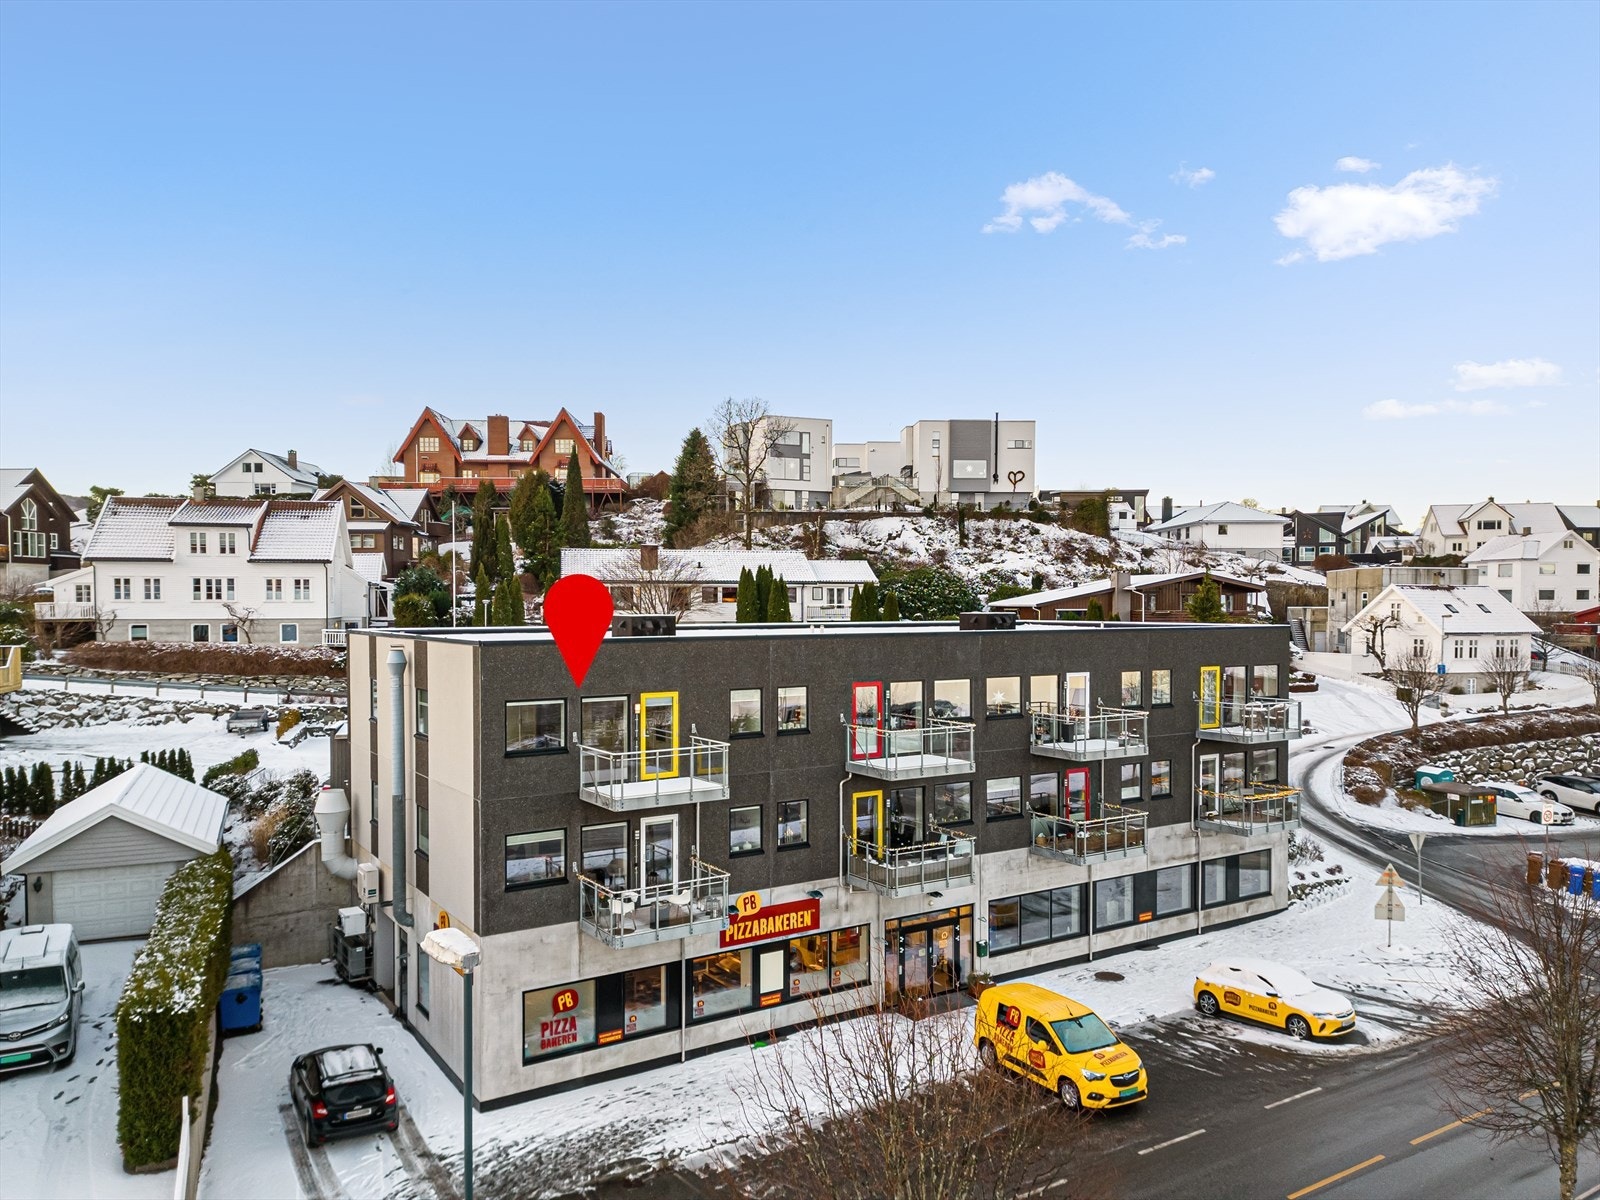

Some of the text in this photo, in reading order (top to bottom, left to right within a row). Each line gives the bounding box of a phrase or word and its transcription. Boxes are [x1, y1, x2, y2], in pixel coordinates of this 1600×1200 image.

[743, 894, 757, 912] PB
[725, 909, 812, 942] PIZZABAKEREN
[557, 992, 574, 1011] PB
[1009, 1008, 1020, 1024] PB
[541, 1016, 577, 1038] PIZZA
[541, 1032, 577, 1050] BAKEREN
